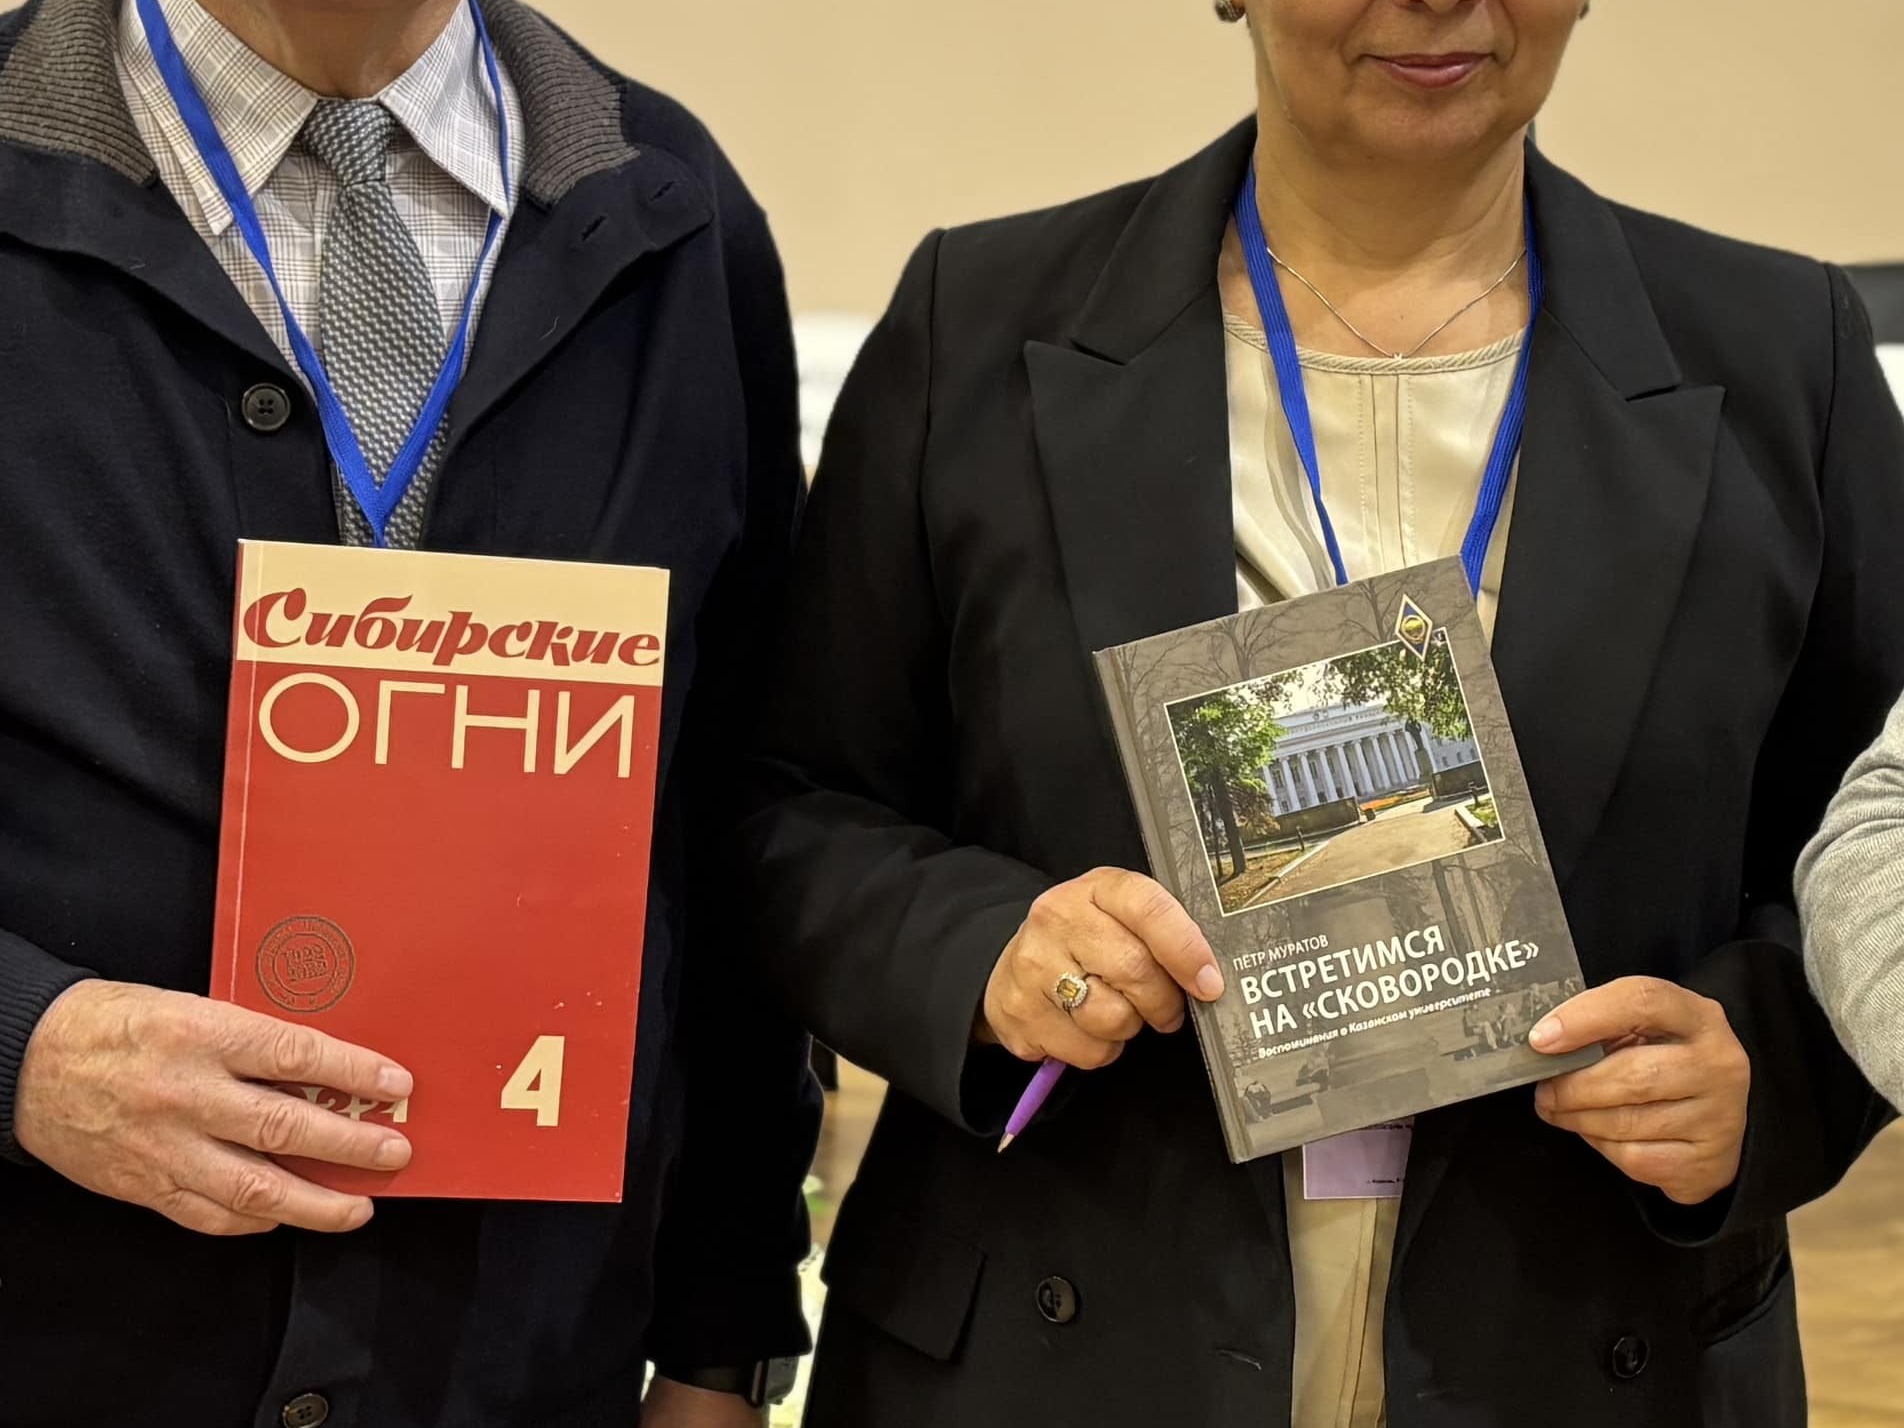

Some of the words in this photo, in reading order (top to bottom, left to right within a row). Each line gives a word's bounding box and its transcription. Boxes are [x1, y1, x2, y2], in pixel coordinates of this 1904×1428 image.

[243, 587, 661, 667] Сибирские
[258, 672, 635, 779] ОГНИ
[1240, 924, 1445, 1005] ВСТРЕТИМСЯ
[1268, 934, 1329, 962] МУРАТОВ
[1249, 1003, 1298, 1039] НА
[1302, 939, 1539, 1020] «СКОВОРОДКЕ»
[1258, 1029, 1339, 1059] Воспоминания
[1340, 1028, 1347, 1037] о
[1348, 1012, 1408, 1034] Казанском
[1408, 987, 1491, 1020] университете
[500, 1035, 566, 1127] 4
